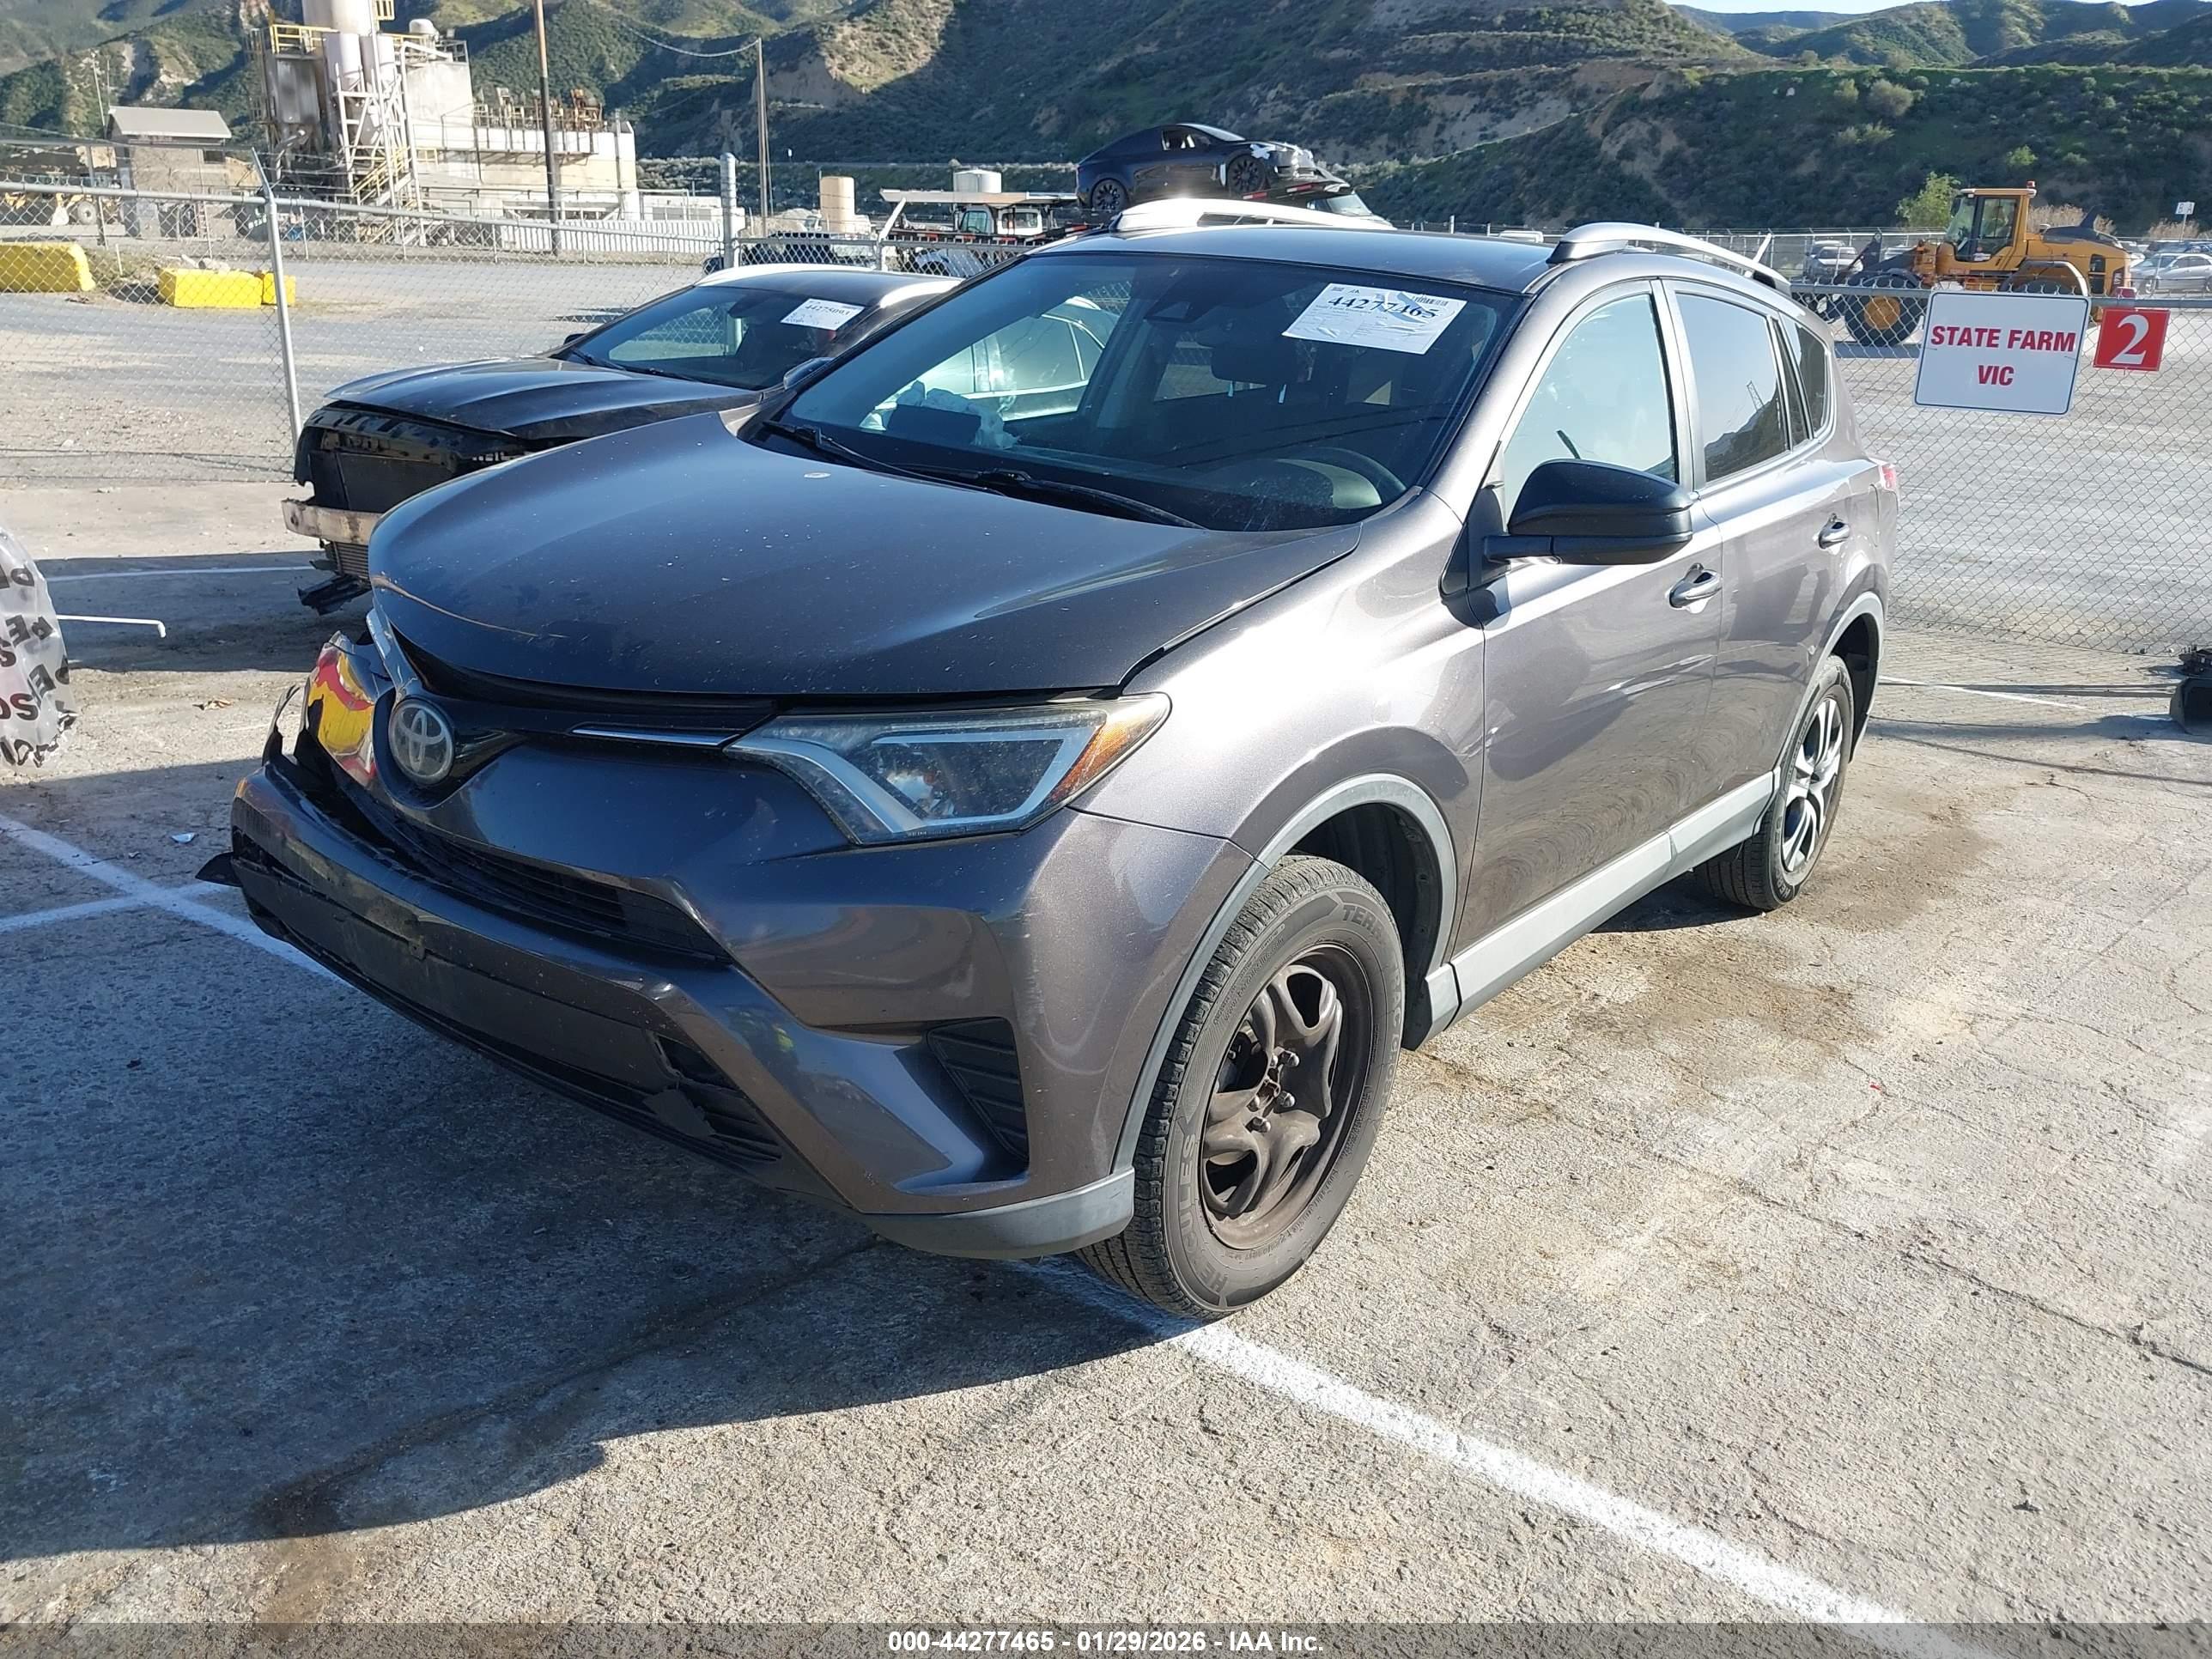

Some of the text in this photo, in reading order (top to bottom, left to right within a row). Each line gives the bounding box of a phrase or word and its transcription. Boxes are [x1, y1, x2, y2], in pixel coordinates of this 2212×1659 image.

[1328, 295, 1439, 319] 44277465
[1930, 325, 2076, 352] STATE FARM
[2110, 314, 2149, 365] 2
[1978, 365, 2014, 386] VIC
[1342, 904, 1387, 950] TERR
[1178, 1133, 1228, 1293] HECULES
